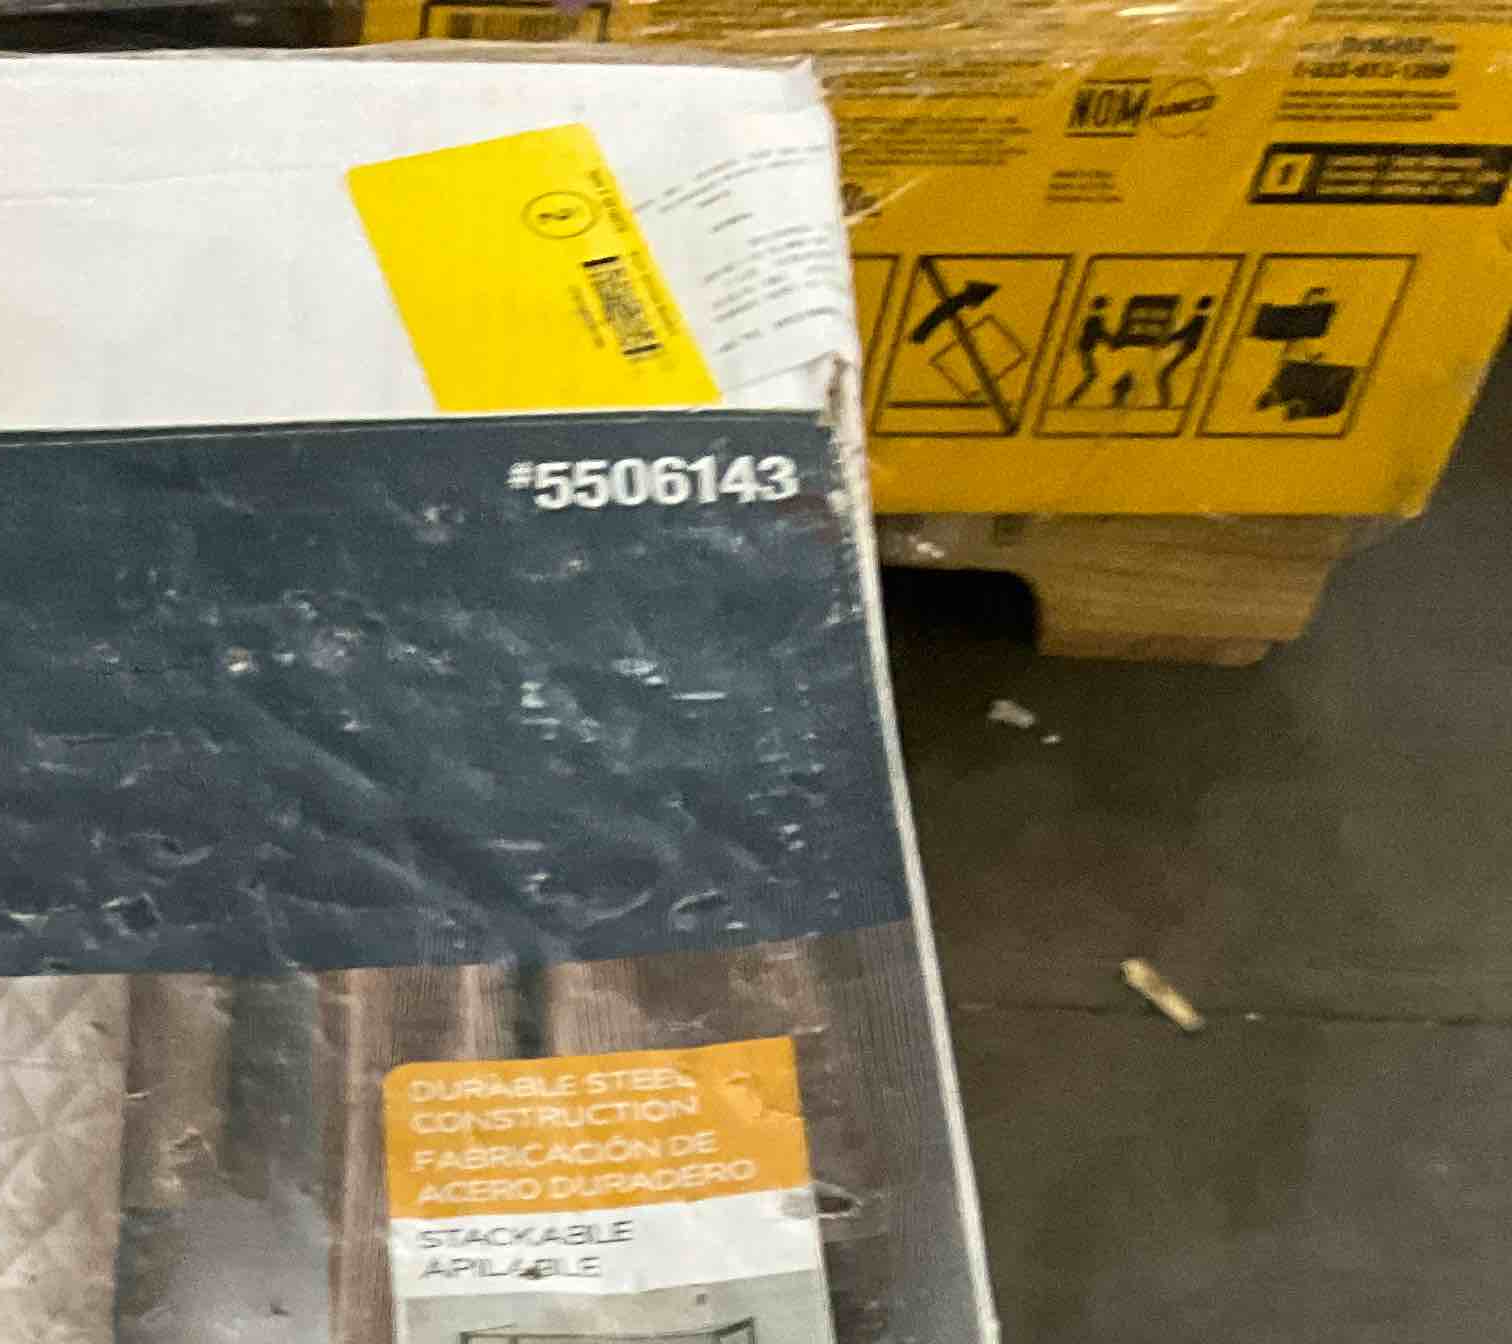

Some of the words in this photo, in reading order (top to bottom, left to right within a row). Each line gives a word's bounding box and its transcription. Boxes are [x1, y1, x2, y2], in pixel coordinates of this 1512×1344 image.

[506, 454, 800, 509] #5506143
[408, 1073, 577, 1103] DURABLE
[585, 1066, 697, 1092] STEEL
[410, 1094, 700, 1135] CONSTRUCTION
[412, 1134, 663, 1172] FABRICACIÓN
[669, 1129, 719, 1156] DE
[417, 1176, 543, 1204] ACERO
[549, 1158, 759, 1199] DURADERO
[416, 1218, 635, 1249] STACKABLE
[420, 1255, 603, 1280] APILABLE
